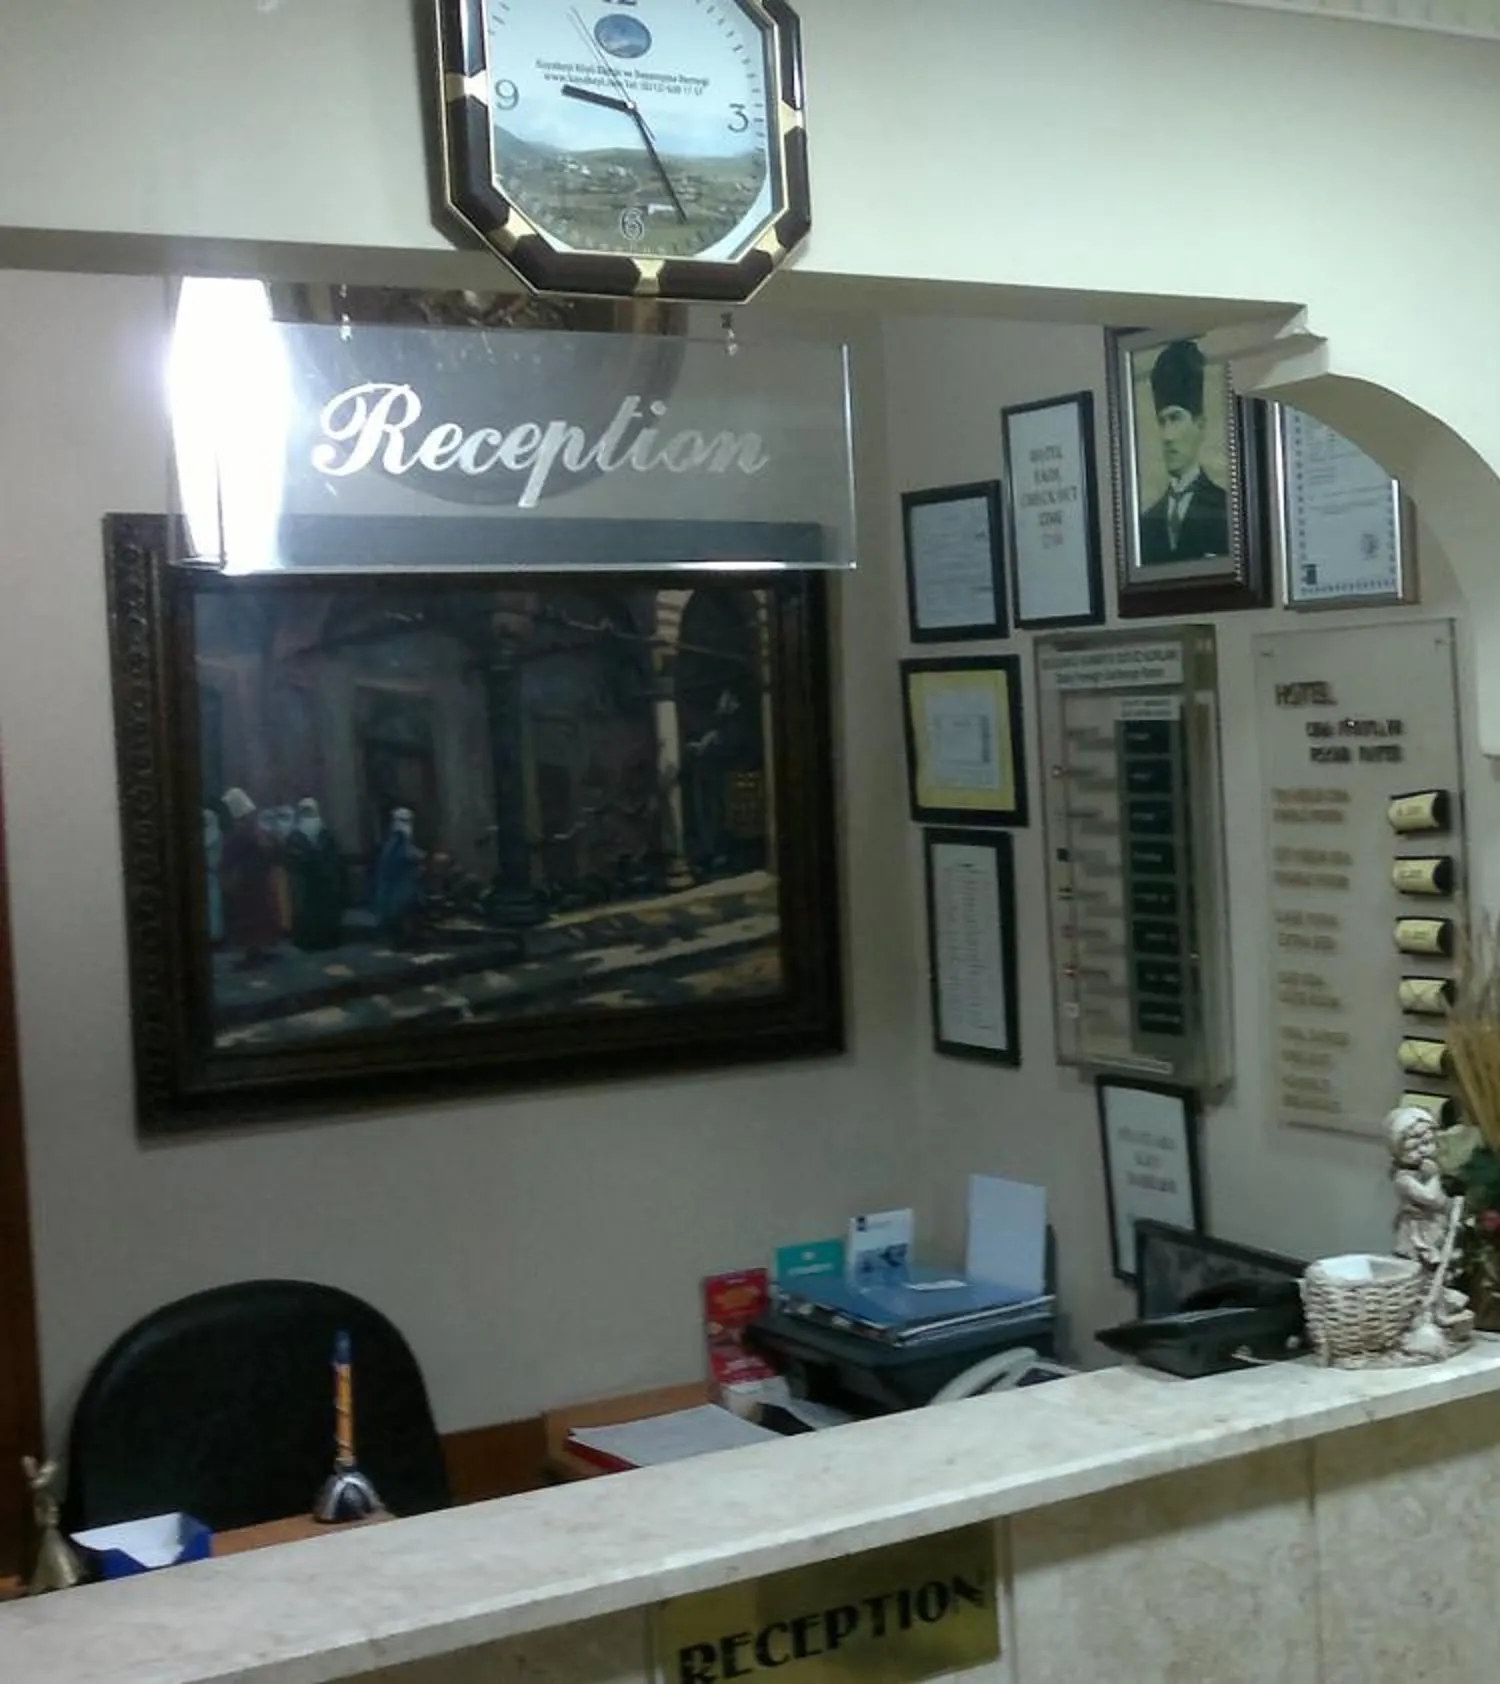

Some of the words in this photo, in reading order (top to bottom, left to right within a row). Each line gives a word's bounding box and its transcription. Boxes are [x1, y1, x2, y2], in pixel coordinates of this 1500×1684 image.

[495, 79, 520, 111] 9
[727, 103, 750, 133] 3
[619, 207, 646, 242] 6
[311, 382, 771, 509] Reception
[1275, 681, 1337, 707] HOTEL
[679, 1567, 988, 1684] RECEPTION
